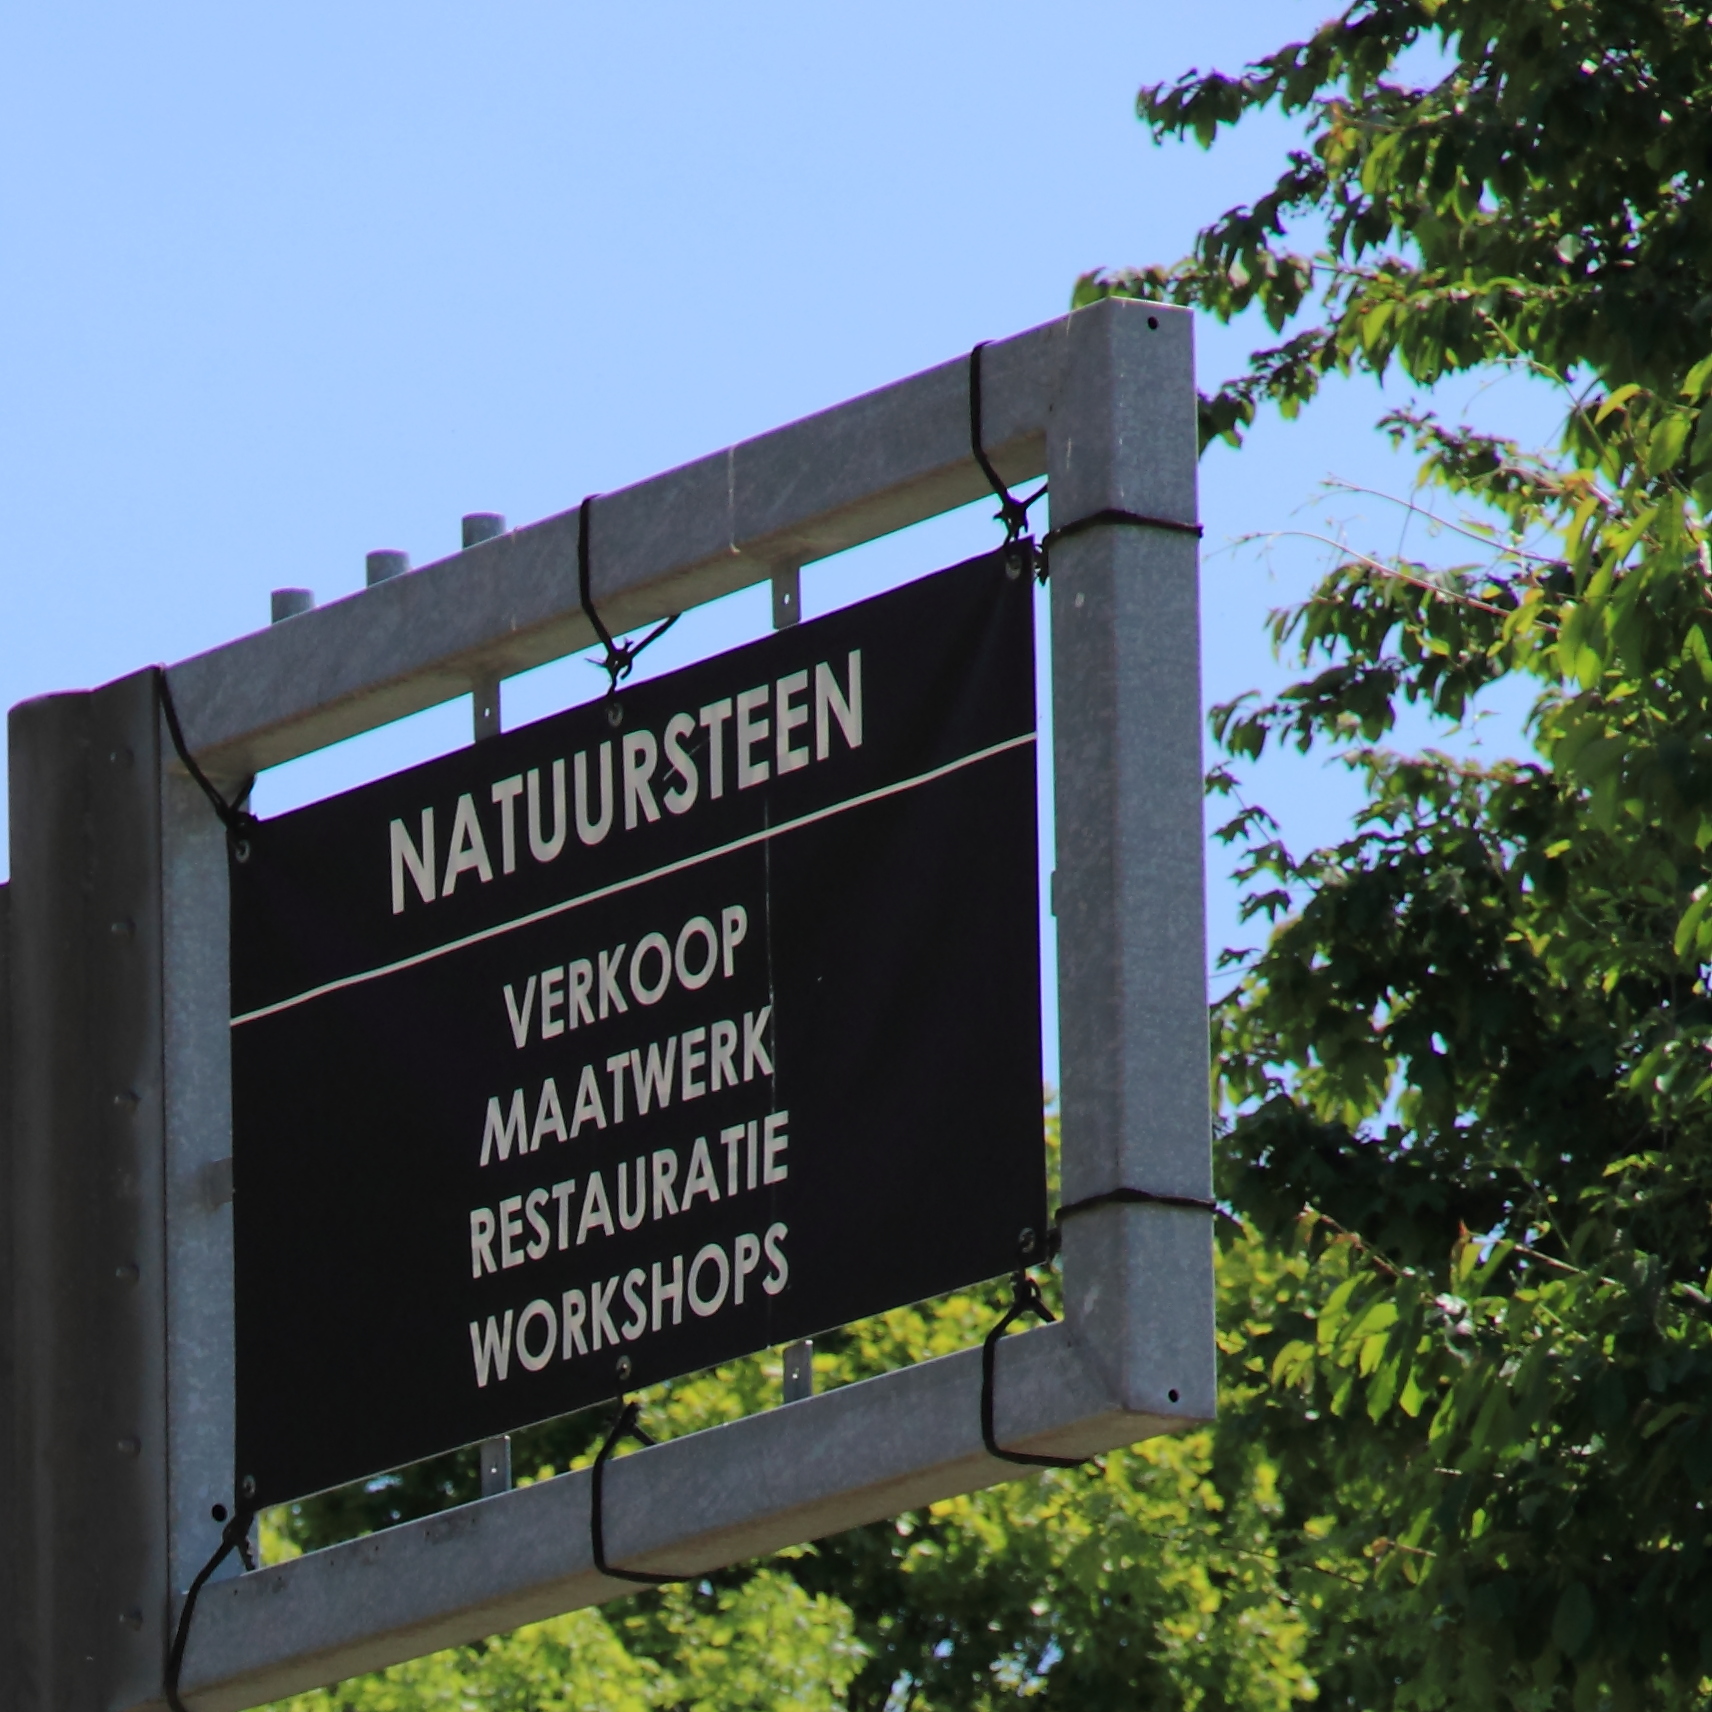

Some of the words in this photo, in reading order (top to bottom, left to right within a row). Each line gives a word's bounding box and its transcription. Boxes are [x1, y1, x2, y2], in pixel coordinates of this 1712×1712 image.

[389, 648, 863, 915] NATUURSTEEN
[502, 904, 748, 1050] VERKOOP
[479, 1004, 776, 1168] MAATWERK
[469, 1109, 789, 1280] RESTAURATIE
[469, 1221, 789, 1388] WORKSHOPS
